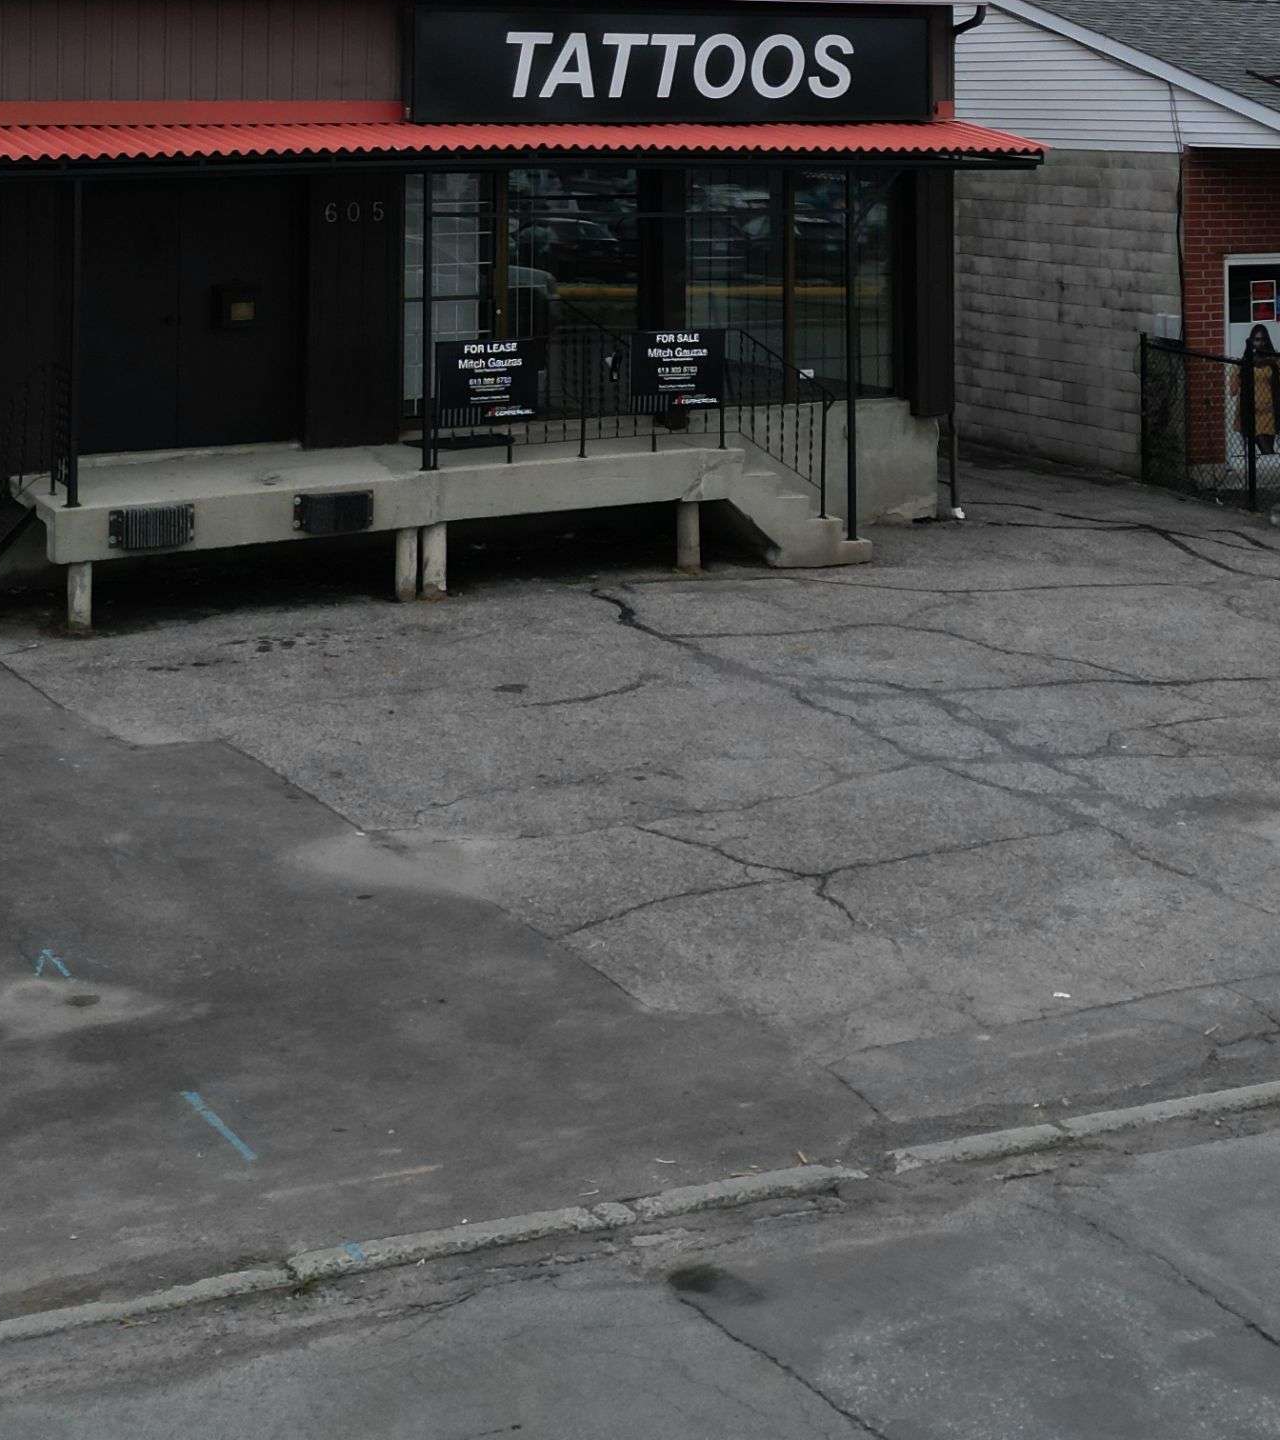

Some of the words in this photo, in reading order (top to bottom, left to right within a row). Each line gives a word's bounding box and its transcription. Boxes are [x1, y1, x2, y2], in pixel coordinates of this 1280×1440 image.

[506, 31, 854, 99] TATTOOS
[325, 201, 384, 222] 605
[656, 334, 675, 343] FOR
[677, 333, 700, 343] SALE
[464, 344, 484, 354] FOR
[487, 342, 518, 353] LEASE
[647, 348, 673, 358] Mitch
[458, 359, 485, 369] Mitch
